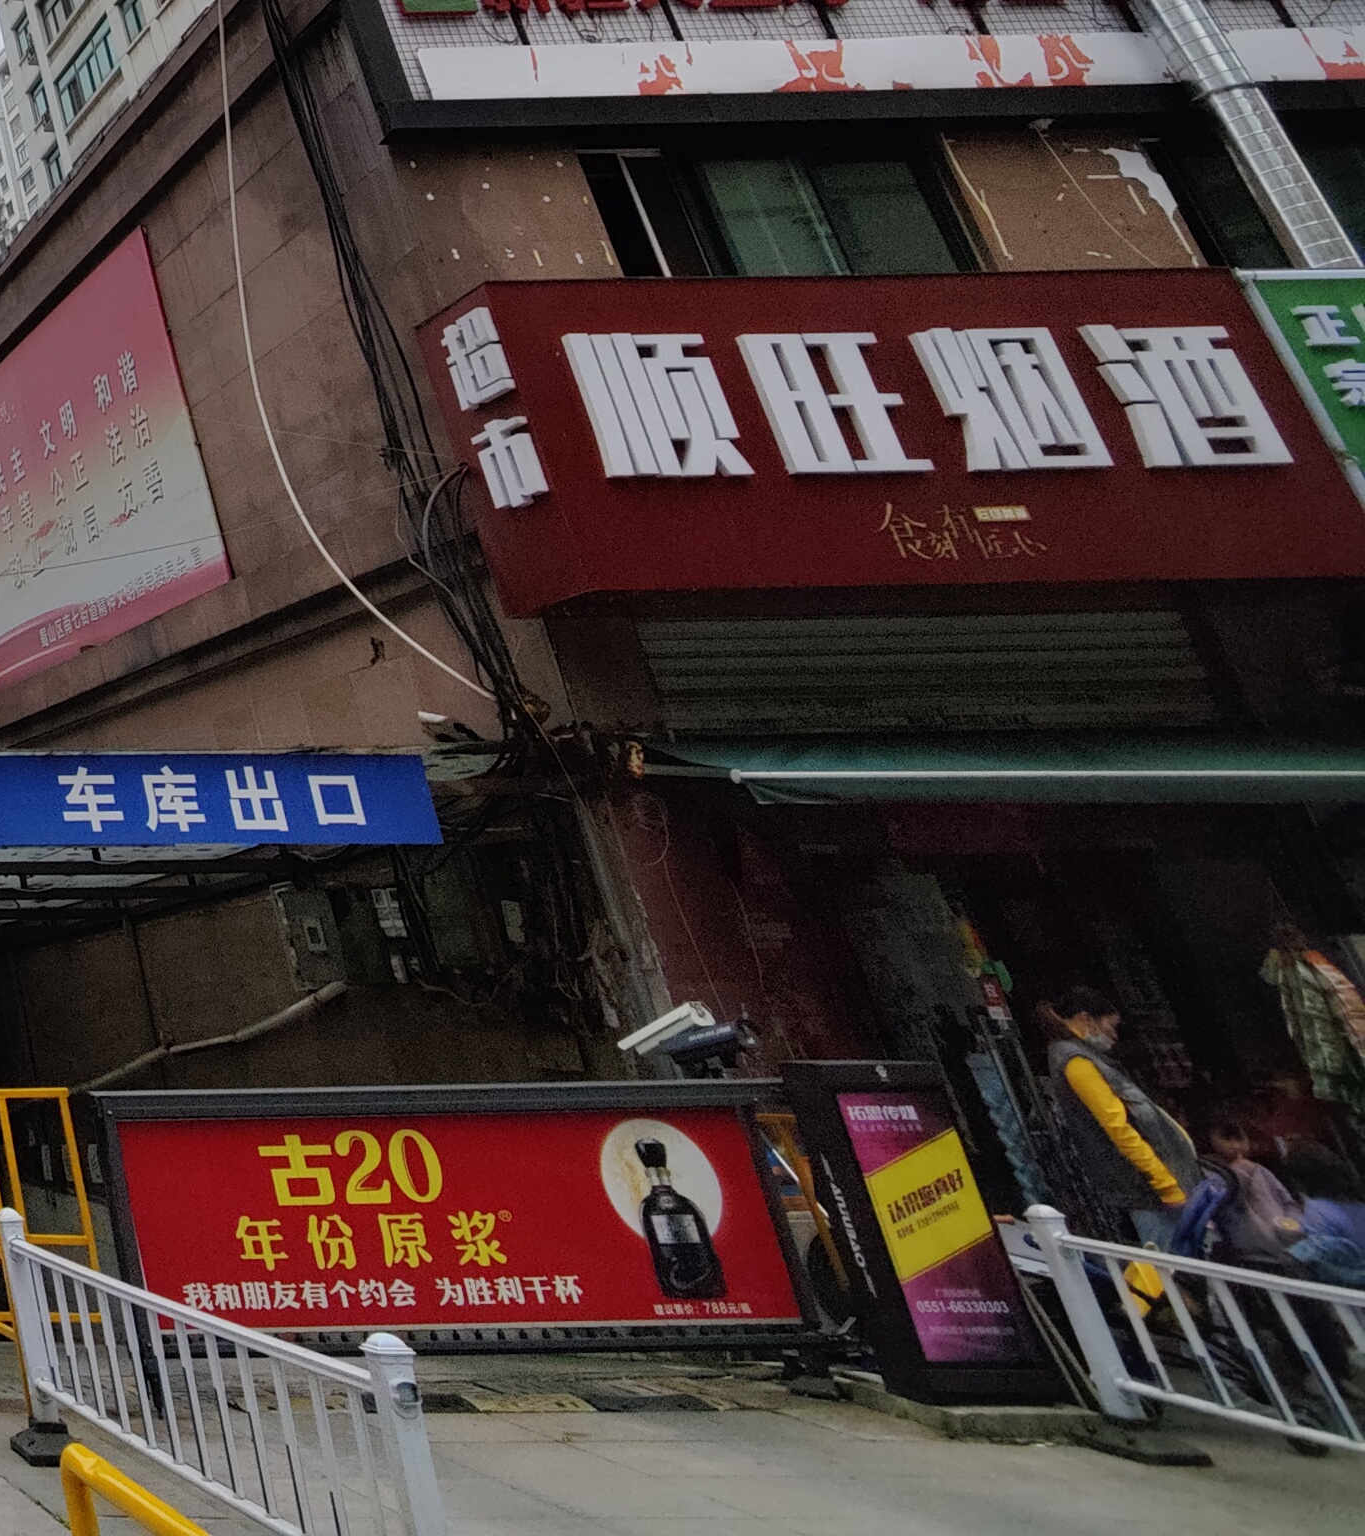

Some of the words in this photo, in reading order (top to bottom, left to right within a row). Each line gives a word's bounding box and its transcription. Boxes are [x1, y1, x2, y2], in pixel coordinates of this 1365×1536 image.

[39, 399, 78, 459] 文明
[92, 350, 138, 414] 和谐
[441, 307, 549, 510] 超市
[561, 325, 1295, 478] 顺旺烟酒
[0, 490, 34, 543] 平等
[50, 450, 89, 507] 公正
[105, 402, 152, 467] 法治
[58, 765, 369, 834] 车库出口
[257, 1129, 443, 1207] 古20
[887, 1168, 965, 1224] 认识您真好
[235, 1210, 508, 1270] 年份原浆
[182, 1279, 417, 1311] 我和朋友有个约会
[436, 1275, 584, 1306] 为胜利干杯
[915, 1300, 1010, 1314] 0551-66330303
